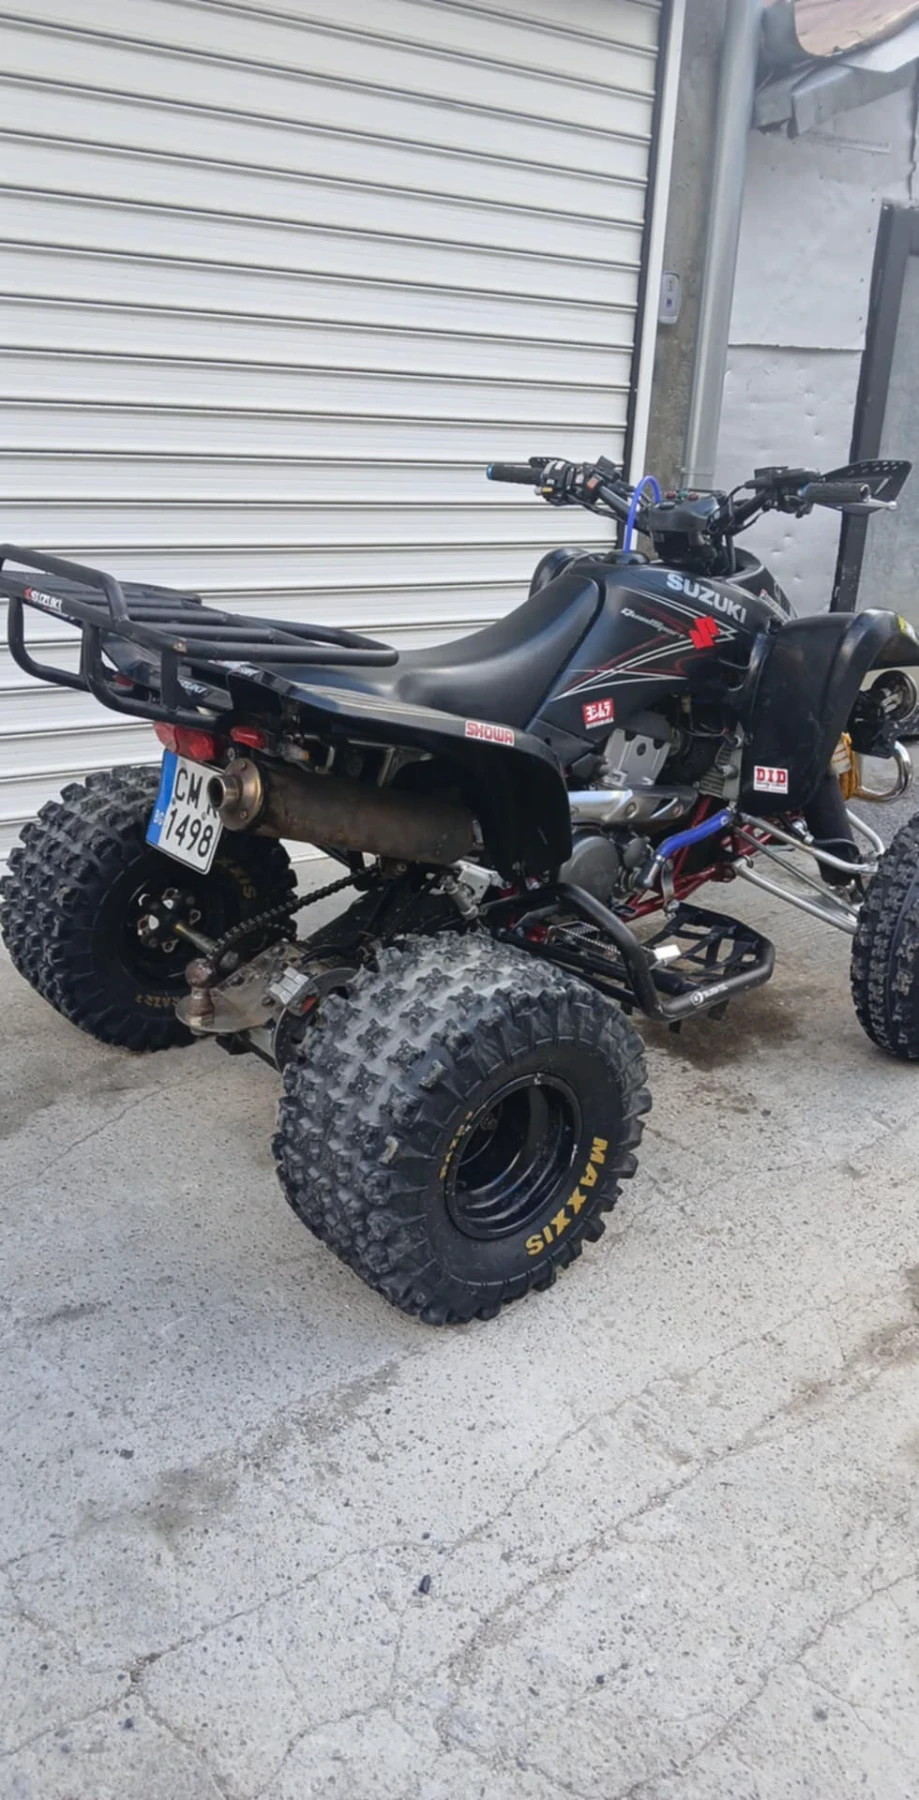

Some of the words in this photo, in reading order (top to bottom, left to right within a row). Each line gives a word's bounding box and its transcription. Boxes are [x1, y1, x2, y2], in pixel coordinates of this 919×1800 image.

[31, 590, 63, 612] SUZUKI
[667, 573, 747, 623] SUZUKI
[467, 722, 513, 744] SHOWA
[175, 767, 203, 809] CM
[756, 767, 786, 784] DID
[165, 807, 214, 858] 1498
[525, 1136, 609, 1256] MAXXIS
